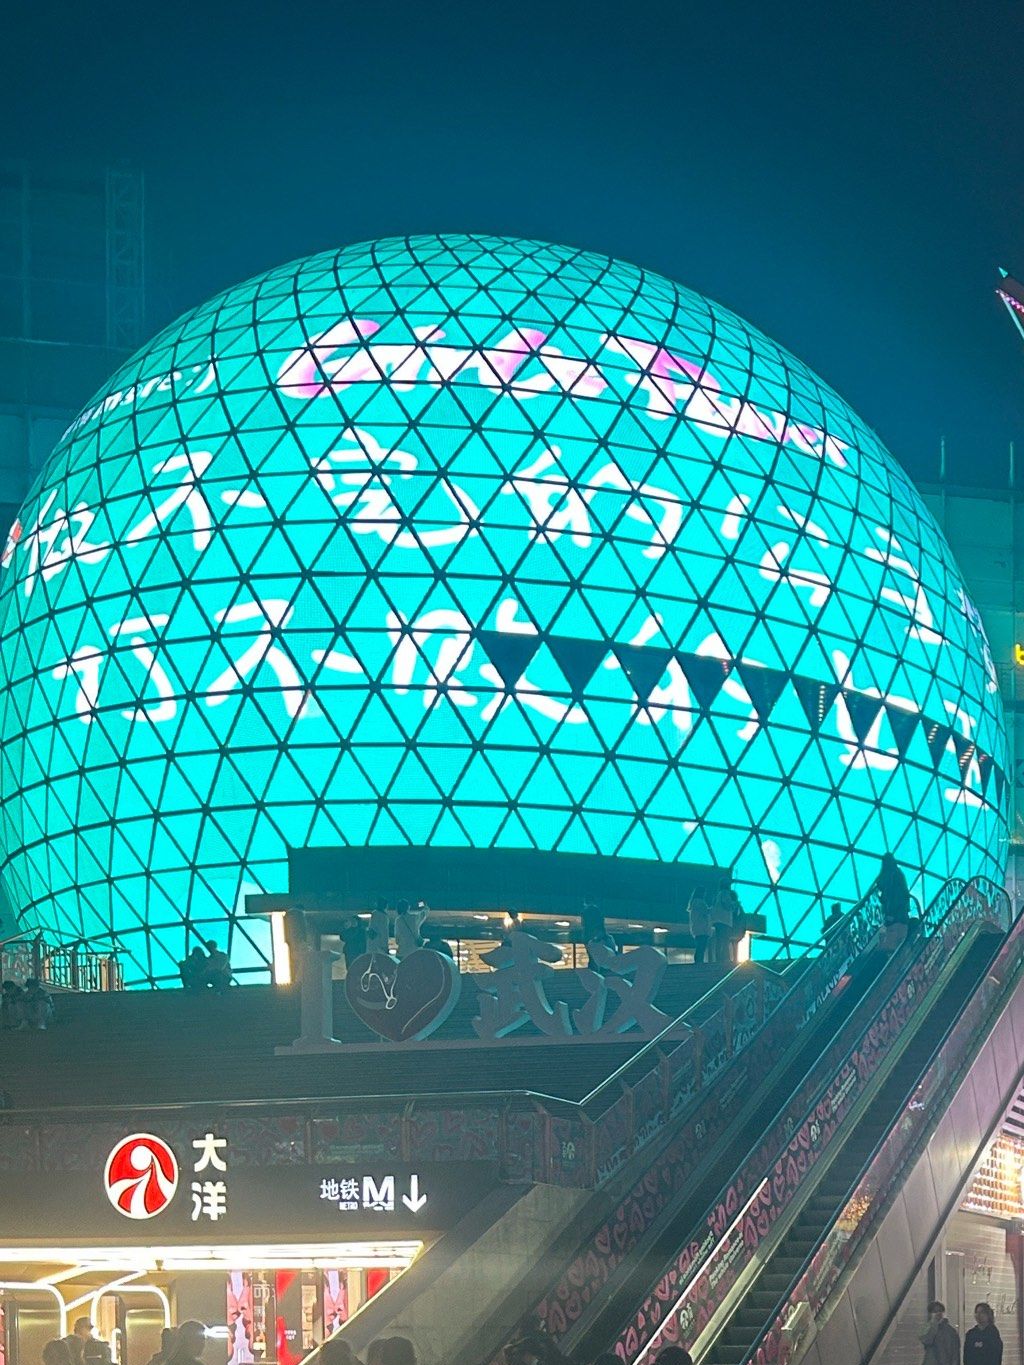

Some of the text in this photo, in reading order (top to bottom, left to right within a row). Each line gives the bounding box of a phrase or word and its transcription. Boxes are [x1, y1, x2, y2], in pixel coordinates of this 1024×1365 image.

[471, 930, 692, 1040] 武汉
[191, 1133, 227, 1221] 大洋
[320, 1178, 360, 1200] 地铁
